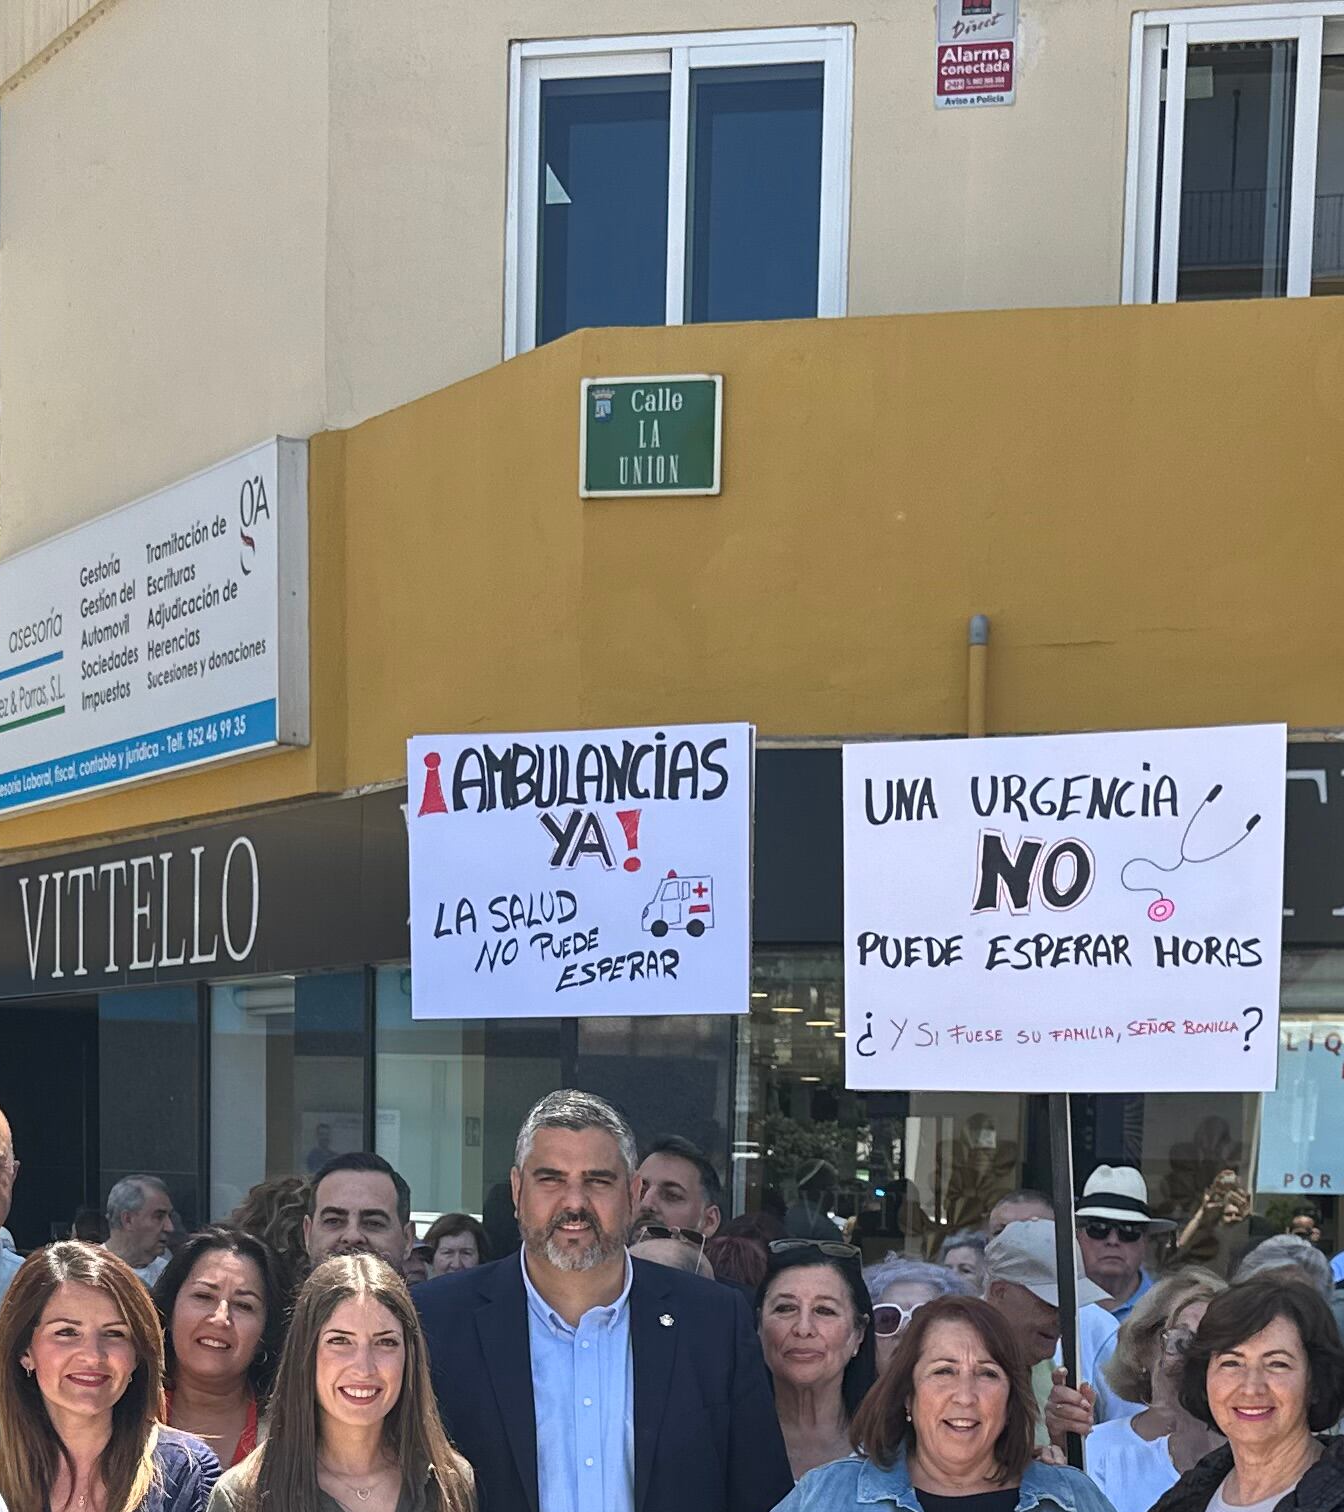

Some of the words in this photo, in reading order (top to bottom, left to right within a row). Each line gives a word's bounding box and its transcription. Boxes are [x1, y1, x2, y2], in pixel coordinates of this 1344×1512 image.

[941, 46, 1010, 63] Alarma
[941, 61, 1010, 76] conectada
[631, 388, 683, 412] Calle
[639, 420, 660, 448] LA
[619, 454, 679, 485] UNION
[146, 520, 208, 564] Tramitación
[211, 514, 227, 537] de
[80, 553, 120, 587] Gestoría
[147, 563, 196, 596] Escrituras
[120, 579, 136, 604] del
[147, 583, 219, 629] Adjudicación
[223, 579, 238, 603] de
[9, 608, 63, 653] asesoría
[81, 613, 130, 649] Automovil
[147, 627, 200, 661] Herencias
[81, 645, 138, 680] Sociedades
[147, 660, 198, 689] Sucesiones
[200, 660, 206, 678] y
[208, 638, 266, 671] donaciones
[10, 692, 18, 714] &
[81, 680, 131, 712] Impuestos
[80, 753, 116, 776] contable
[125, 743, 159, 769] jurídica
[187, 725, 204, 748] 952
[206, 723, 217, 742] 46
[219, 719, 231, 738] 99
[234, 714, 247, 735] 35
[865, 777, 939, 825] UNA
[971, 762, 1178, 822] URGENCIA
[536, 808, 642, 872] YA!
[971, 828, 1096, 916] NO
[18, 835, 260, 979] VITTELLO
[434, 897, 477, 938] LA
[488, 890, 577, 933] SALUD
[474, 938, 519, 973] NO
[530, 927, 599, 961] PUEDE
[857, 931, 964, 969] PUEDE
[986, 934, 1132, 970] ESPERAR
[1155, 935, 1263, 968] HORAS
[556, 949, 679, 992] ESPERAR
[915, 1022, 939, 1047] SI
[947, 1025, 1003, 1043] FUESE
[1017, 1029, 1041, 1045] SU
[1127, 1018, 1175, 1037] SEÑOR
[1284, 1172, 1331, 1190] POR
